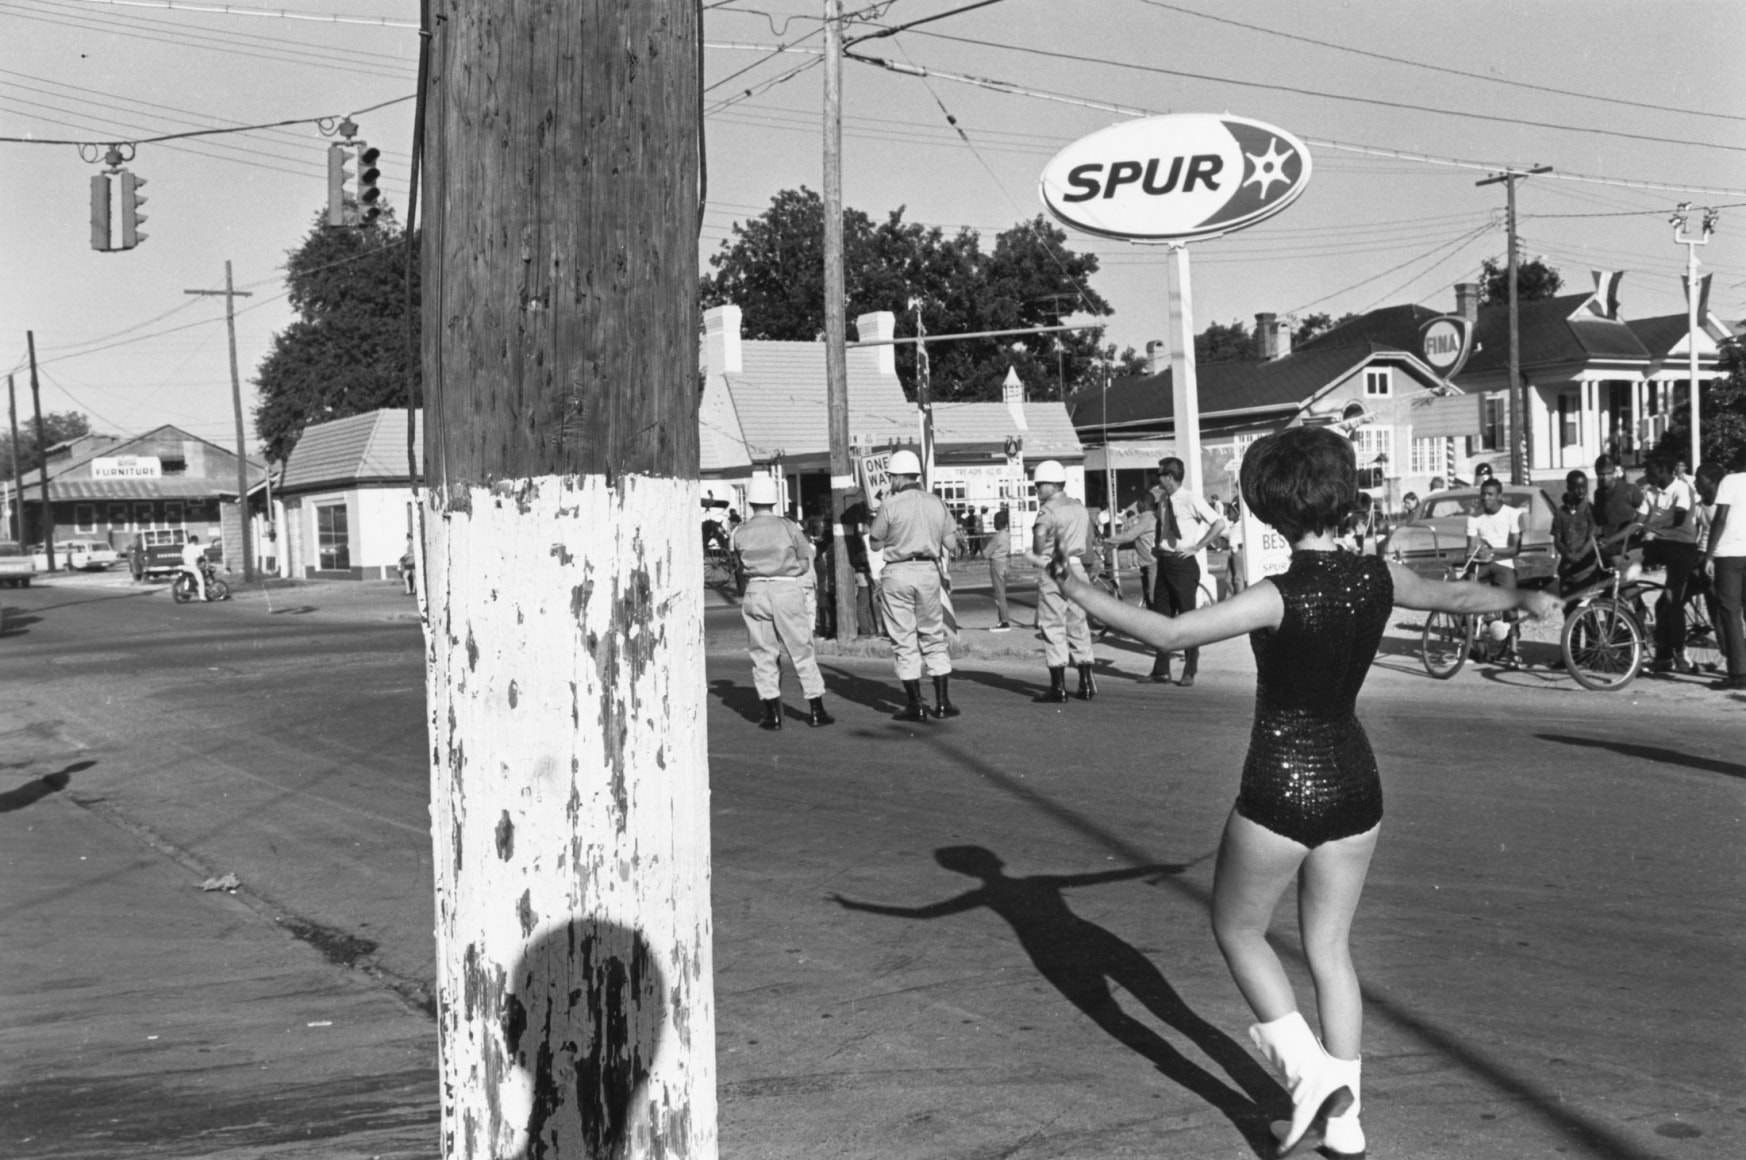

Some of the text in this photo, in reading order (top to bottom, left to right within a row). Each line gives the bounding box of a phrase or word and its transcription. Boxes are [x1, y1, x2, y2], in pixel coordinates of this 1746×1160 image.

[1062, 153, 1225, 203] SPUR
[1425, 333, 1459, 356] FINA
[95, 467, 155, 476] FURNITURE
[866, 456, 889, 473] ONE
[868, 471, 892, 487] WAY
[1262, 533, 1287, 550] BES
[1262, 562, 1288, 573] SPUR
